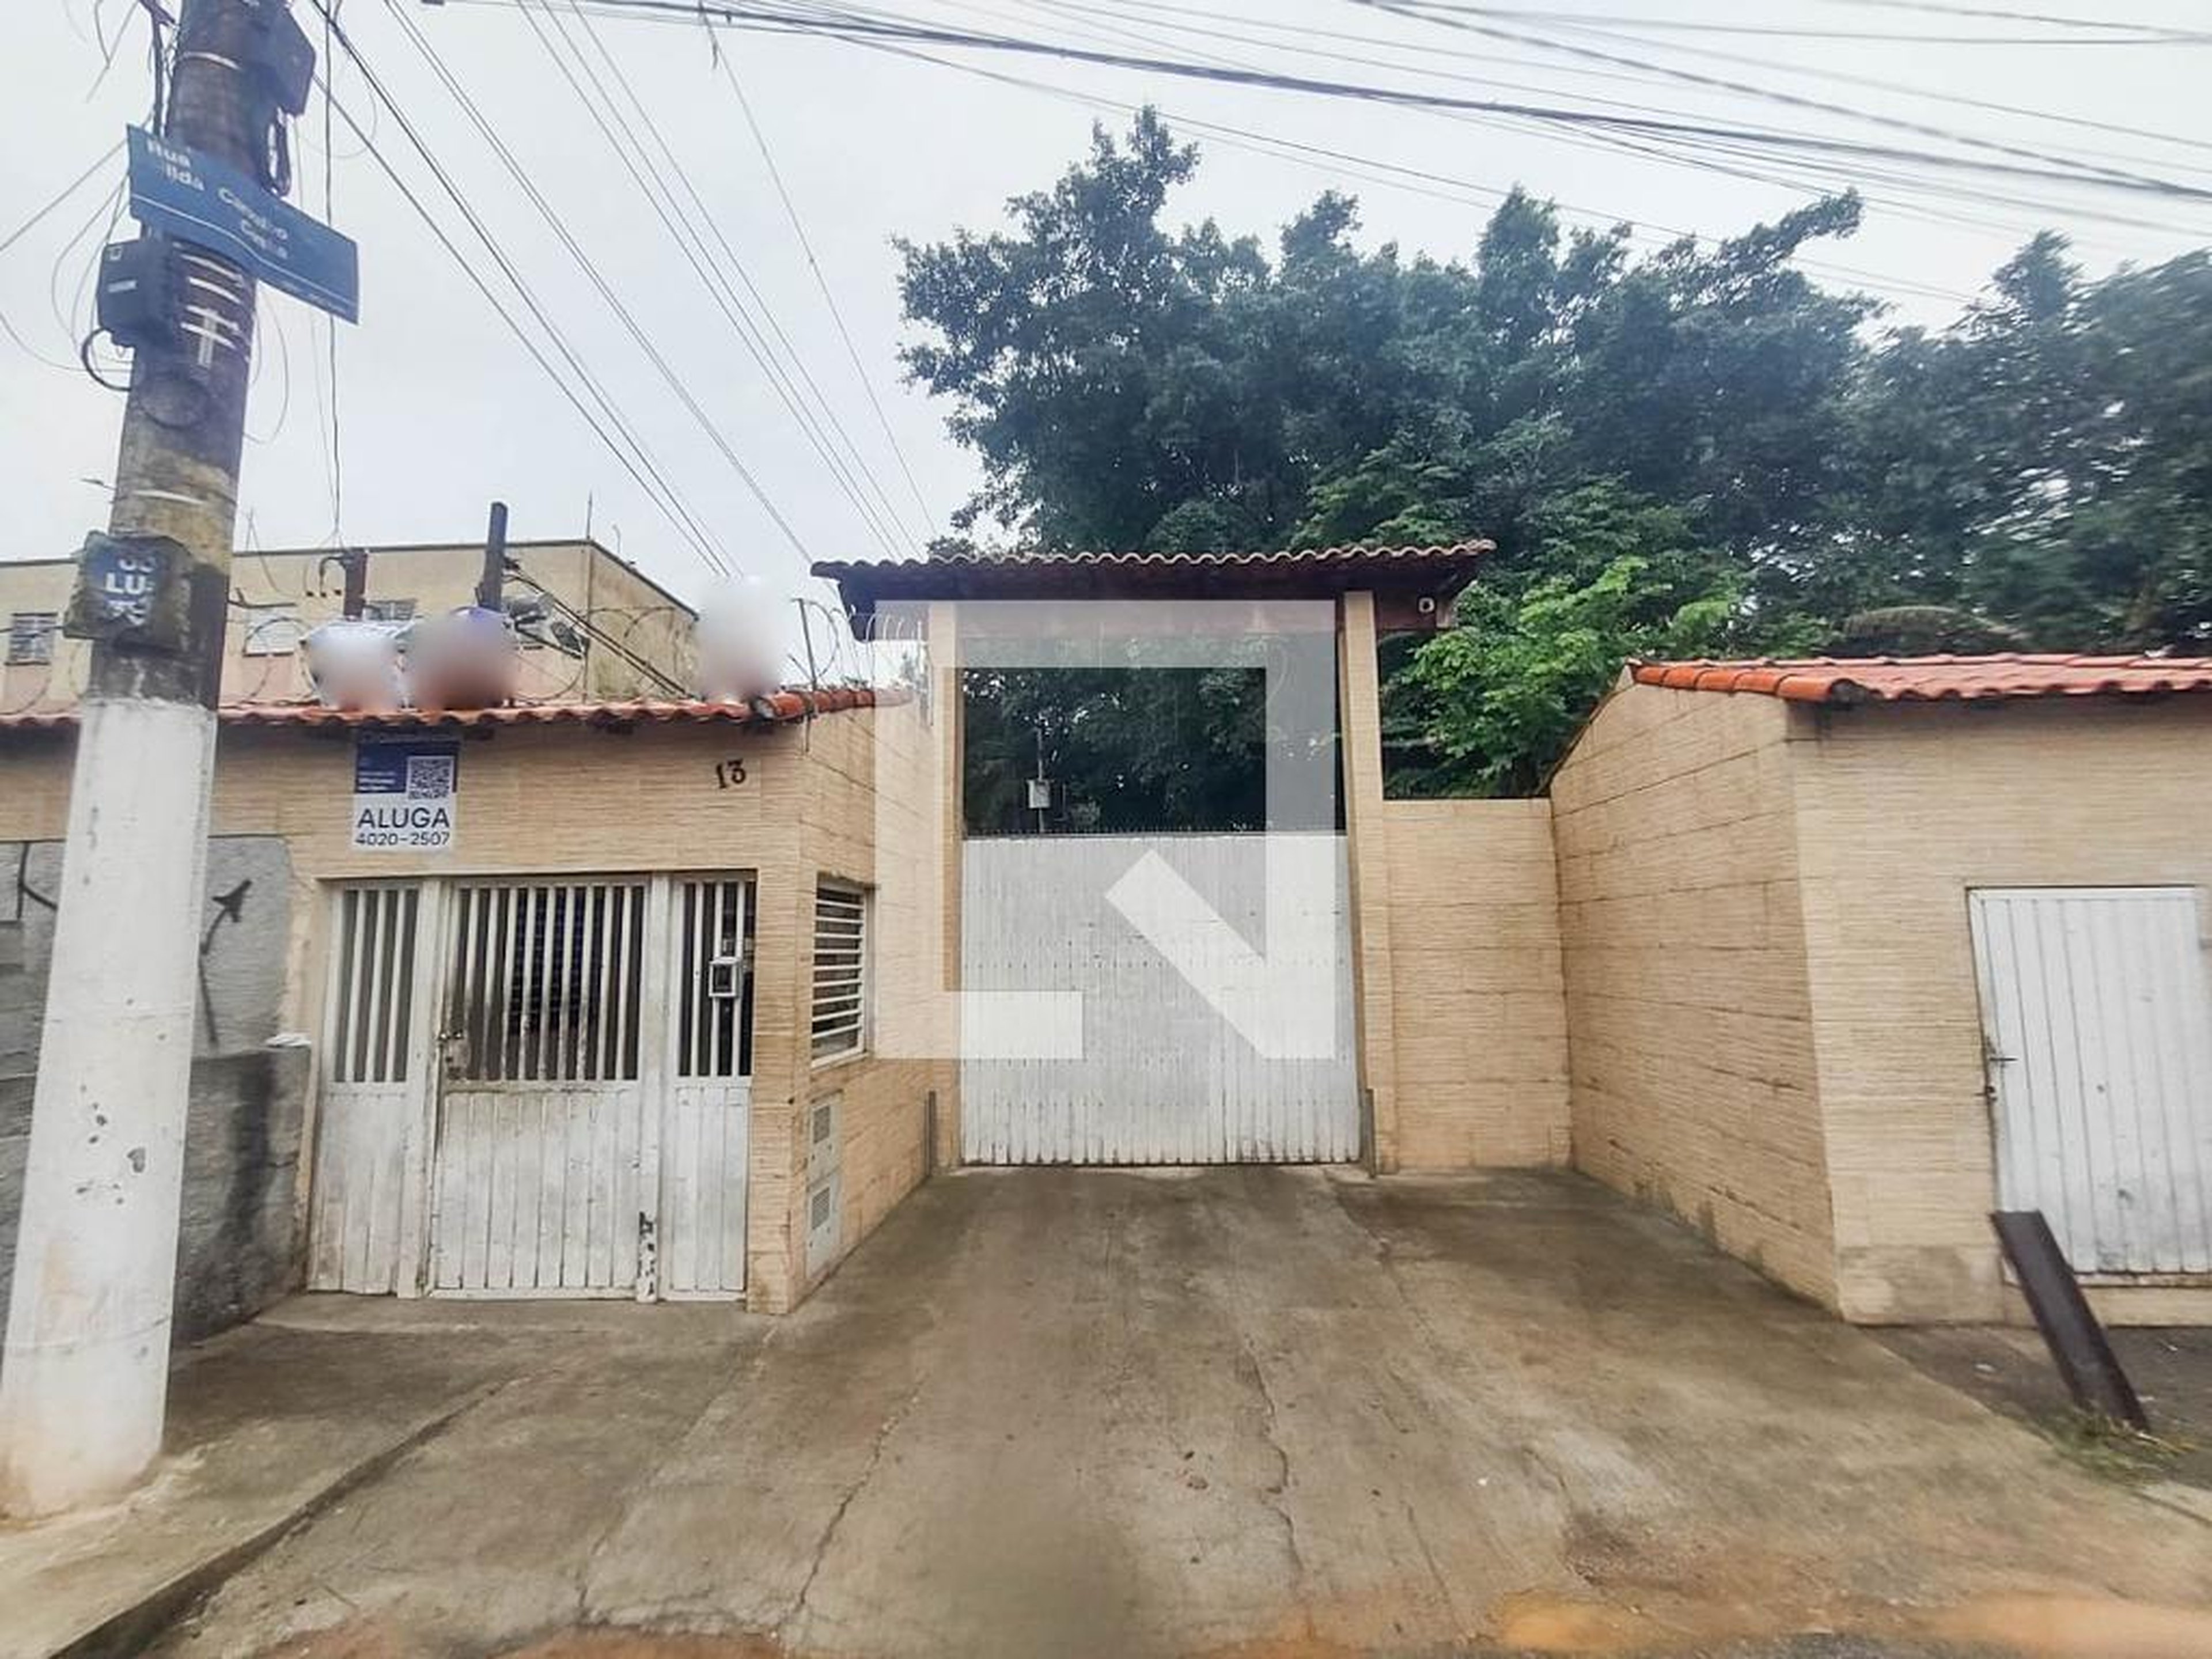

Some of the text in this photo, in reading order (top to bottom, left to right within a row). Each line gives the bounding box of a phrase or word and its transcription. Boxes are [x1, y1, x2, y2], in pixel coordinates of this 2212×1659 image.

[715, 758, 747, 790] 13
[357, 807, 450, 829] ALUGA
[355, 832, 450, 846] 4020-2507
